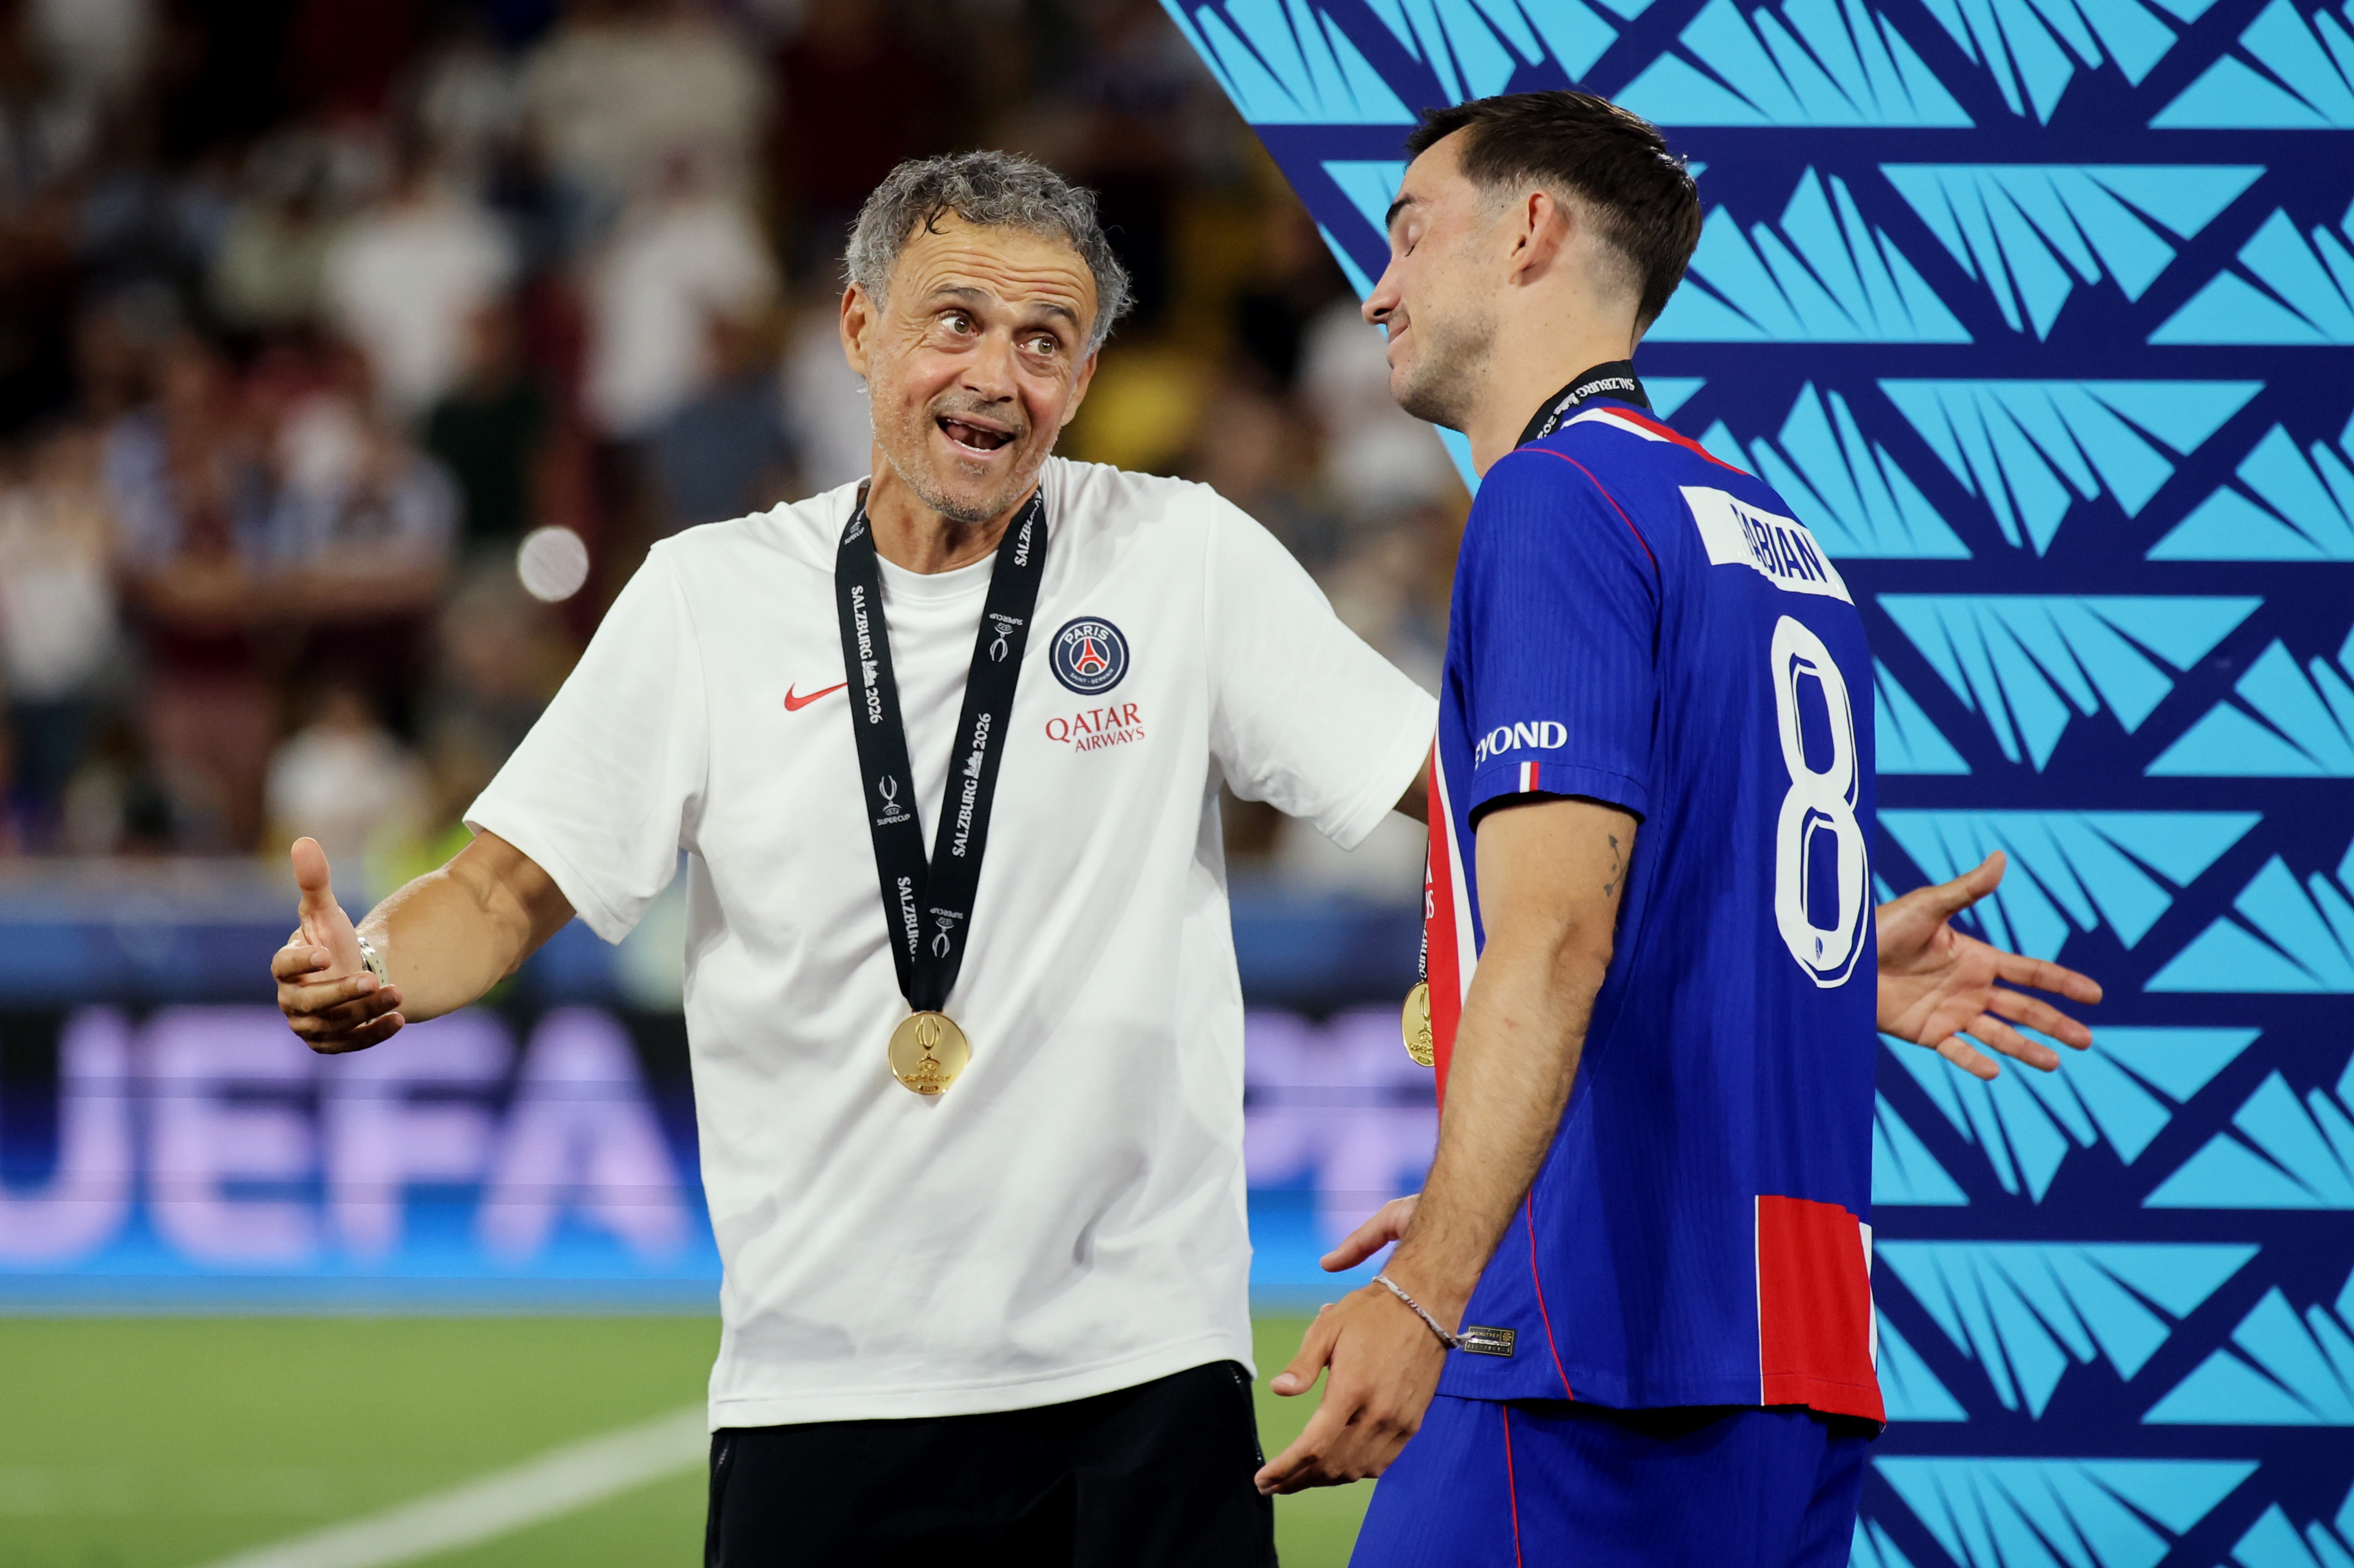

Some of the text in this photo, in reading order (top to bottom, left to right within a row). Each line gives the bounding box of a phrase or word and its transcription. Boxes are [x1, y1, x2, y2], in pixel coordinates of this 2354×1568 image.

[1575, 377, 1635, 397] SALZBURG
[851, 585, 884, 724] SALZBURG 2026
[1064, 624, 1110, 645] PARIS
[1045, 702, 1142, 743] QATAR
[1075, 726, 1145, 753] AIRWAYS
[1474, 720, 1568, 771] EYOND
[952, 712, 992, 858] SALZBURG 2026
[1771, 615, 1870, 988] 8
